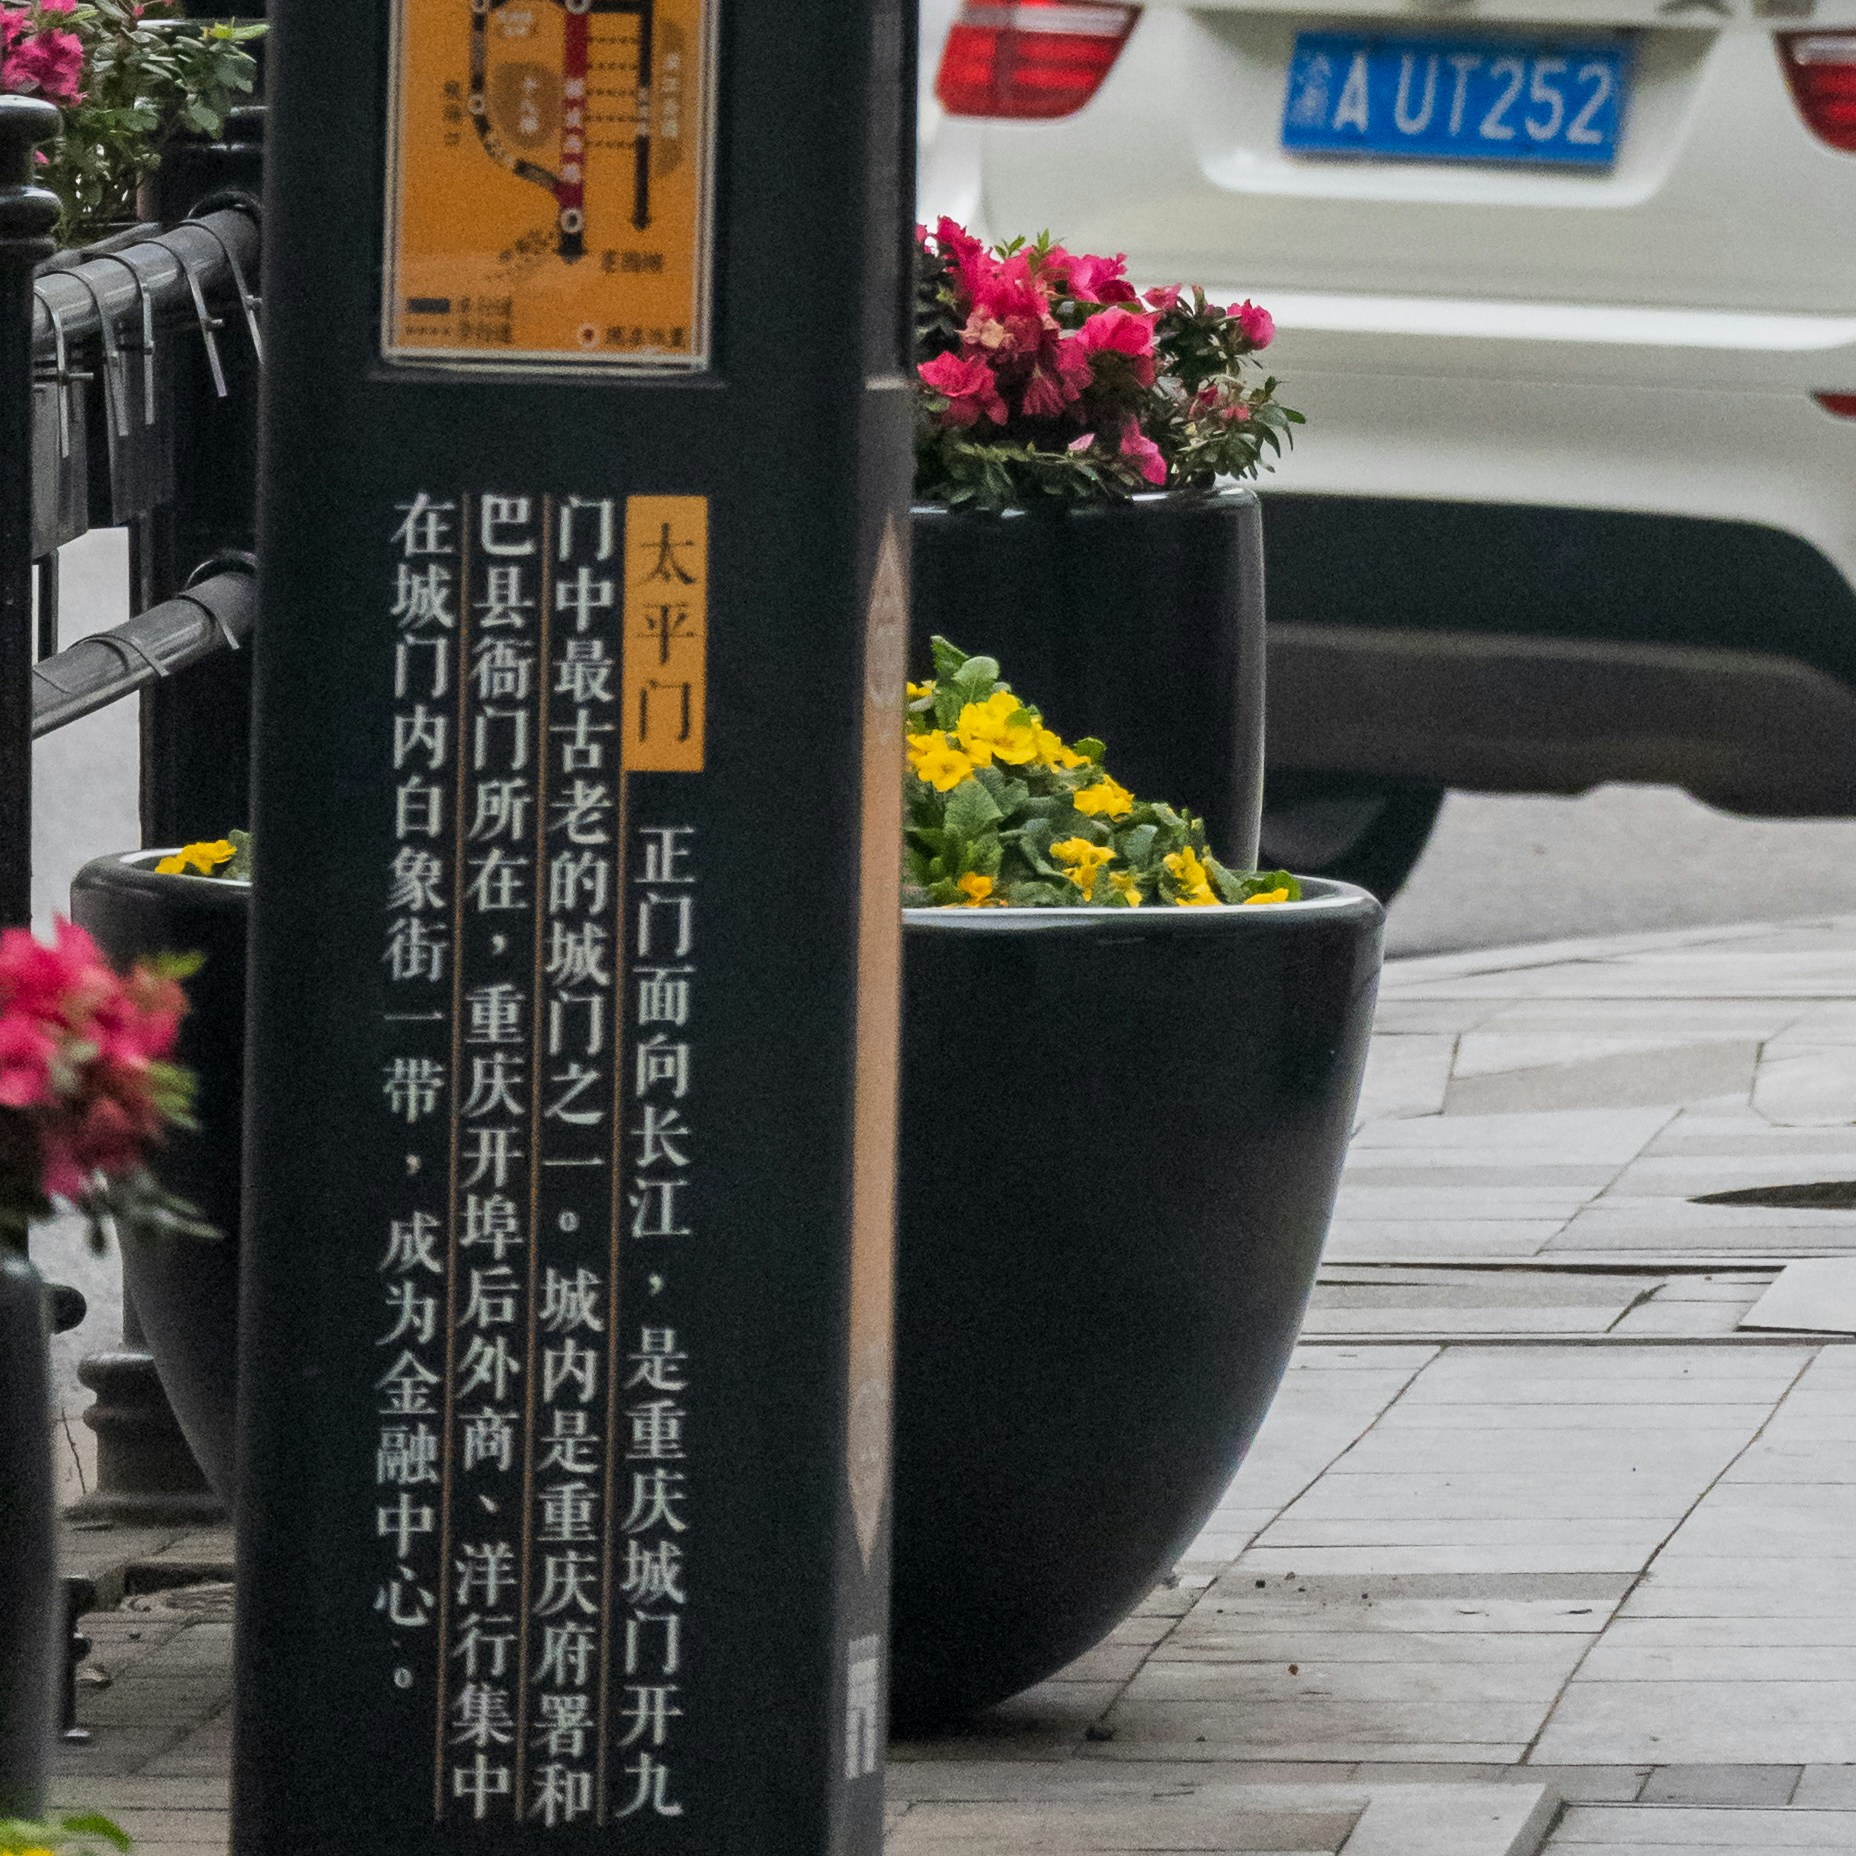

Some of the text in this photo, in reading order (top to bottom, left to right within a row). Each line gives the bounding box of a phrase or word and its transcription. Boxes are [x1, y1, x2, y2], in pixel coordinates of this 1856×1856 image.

[375, 492, 455, 1688] 在城门内白象街一带，成为金融中心。
[453, 493, 534, 1818] 巴县衙门所在，重庆开埠后外商、洋行集中
[534, 495, 613, 1826] 门中最古老的城门之一。城内是重庆府署和
[636, 522, 699, 744] 太平门
[618, 826, 695, 1816] 正门面向长江，是重庆城门开九
